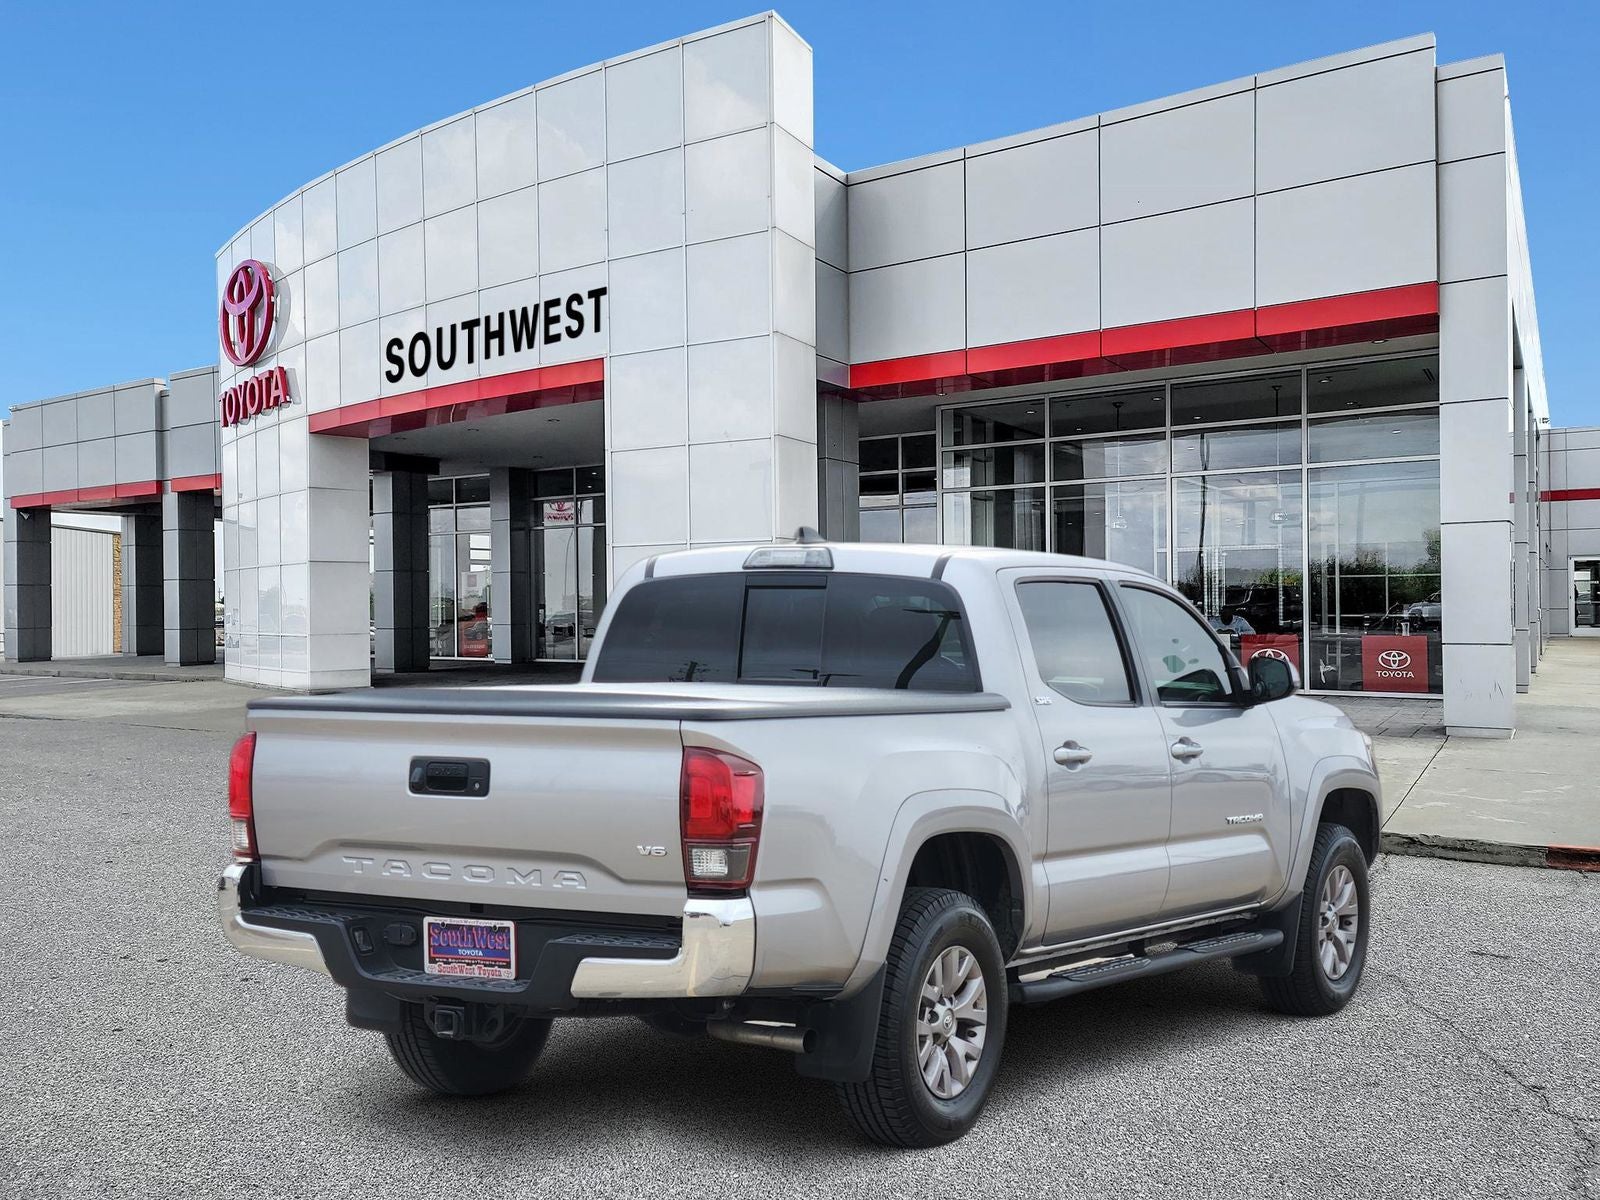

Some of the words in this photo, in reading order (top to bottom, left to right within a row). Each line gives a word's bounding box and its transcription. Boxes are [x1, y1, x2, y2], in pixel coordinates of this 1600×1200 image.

[385, 286, 608, 384] SOUTHWEST
[218, 366, 291, 428] TOYOTA
[1376, 670, 1415, 679] TOYOTA
[636, 845, 668, 857] V6
[342, 855, 588, 890] TACOMA
[430, 925, 510, 950] SouthWest
[437, 963, 476, 976] SouthWest
[477, 965, 503, 978] Toyota
